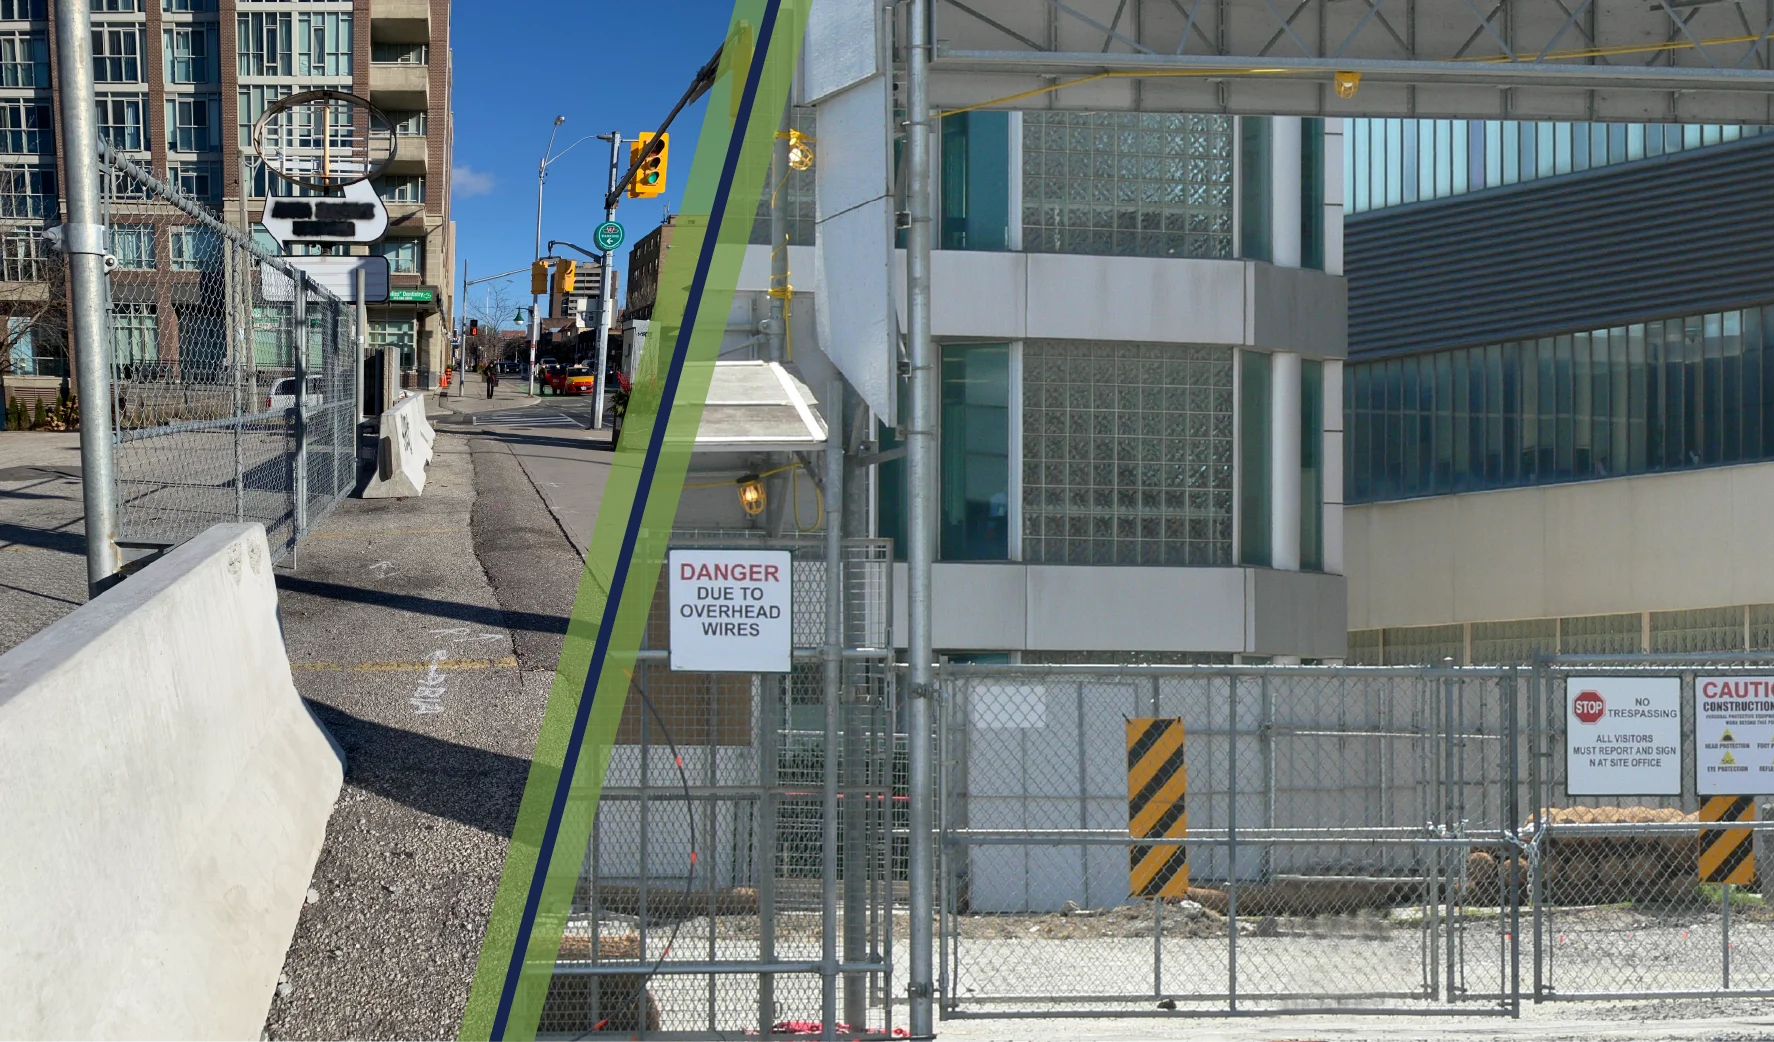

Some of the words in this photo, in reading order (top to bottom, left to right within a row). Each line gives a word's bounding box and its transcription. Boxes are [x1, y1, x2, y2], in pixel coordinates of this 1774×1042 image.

[680, 563, 780, 582] DANGER
[697, 586, 734, 601] DUE
[740, 587, 764, 601] TO
[680, 604, 781, 619] OVERHEAD
[702, 622, 760, 637] WIRES
[1575, 700, 1603, 714] STOP
[1635, 698, 1650, 707] NO
[1608, 709, 1678, 718] TRESPASSING
[1596, 734, 1612, 743] ALL
[1614, 734, 1654, 743] VISITORS
[1573, 746, 1597, 755] MUST
[1598, 746, 1633, 755] REPORT
[1635, 746, 1654, 755] AND
[1656, 746, 1677, 755] SIGN
[1597, 759, 1608, 767] AT
[1610, 759, 1630, 767] SITE
[1631, 759, 1662, 767] OFFICE
